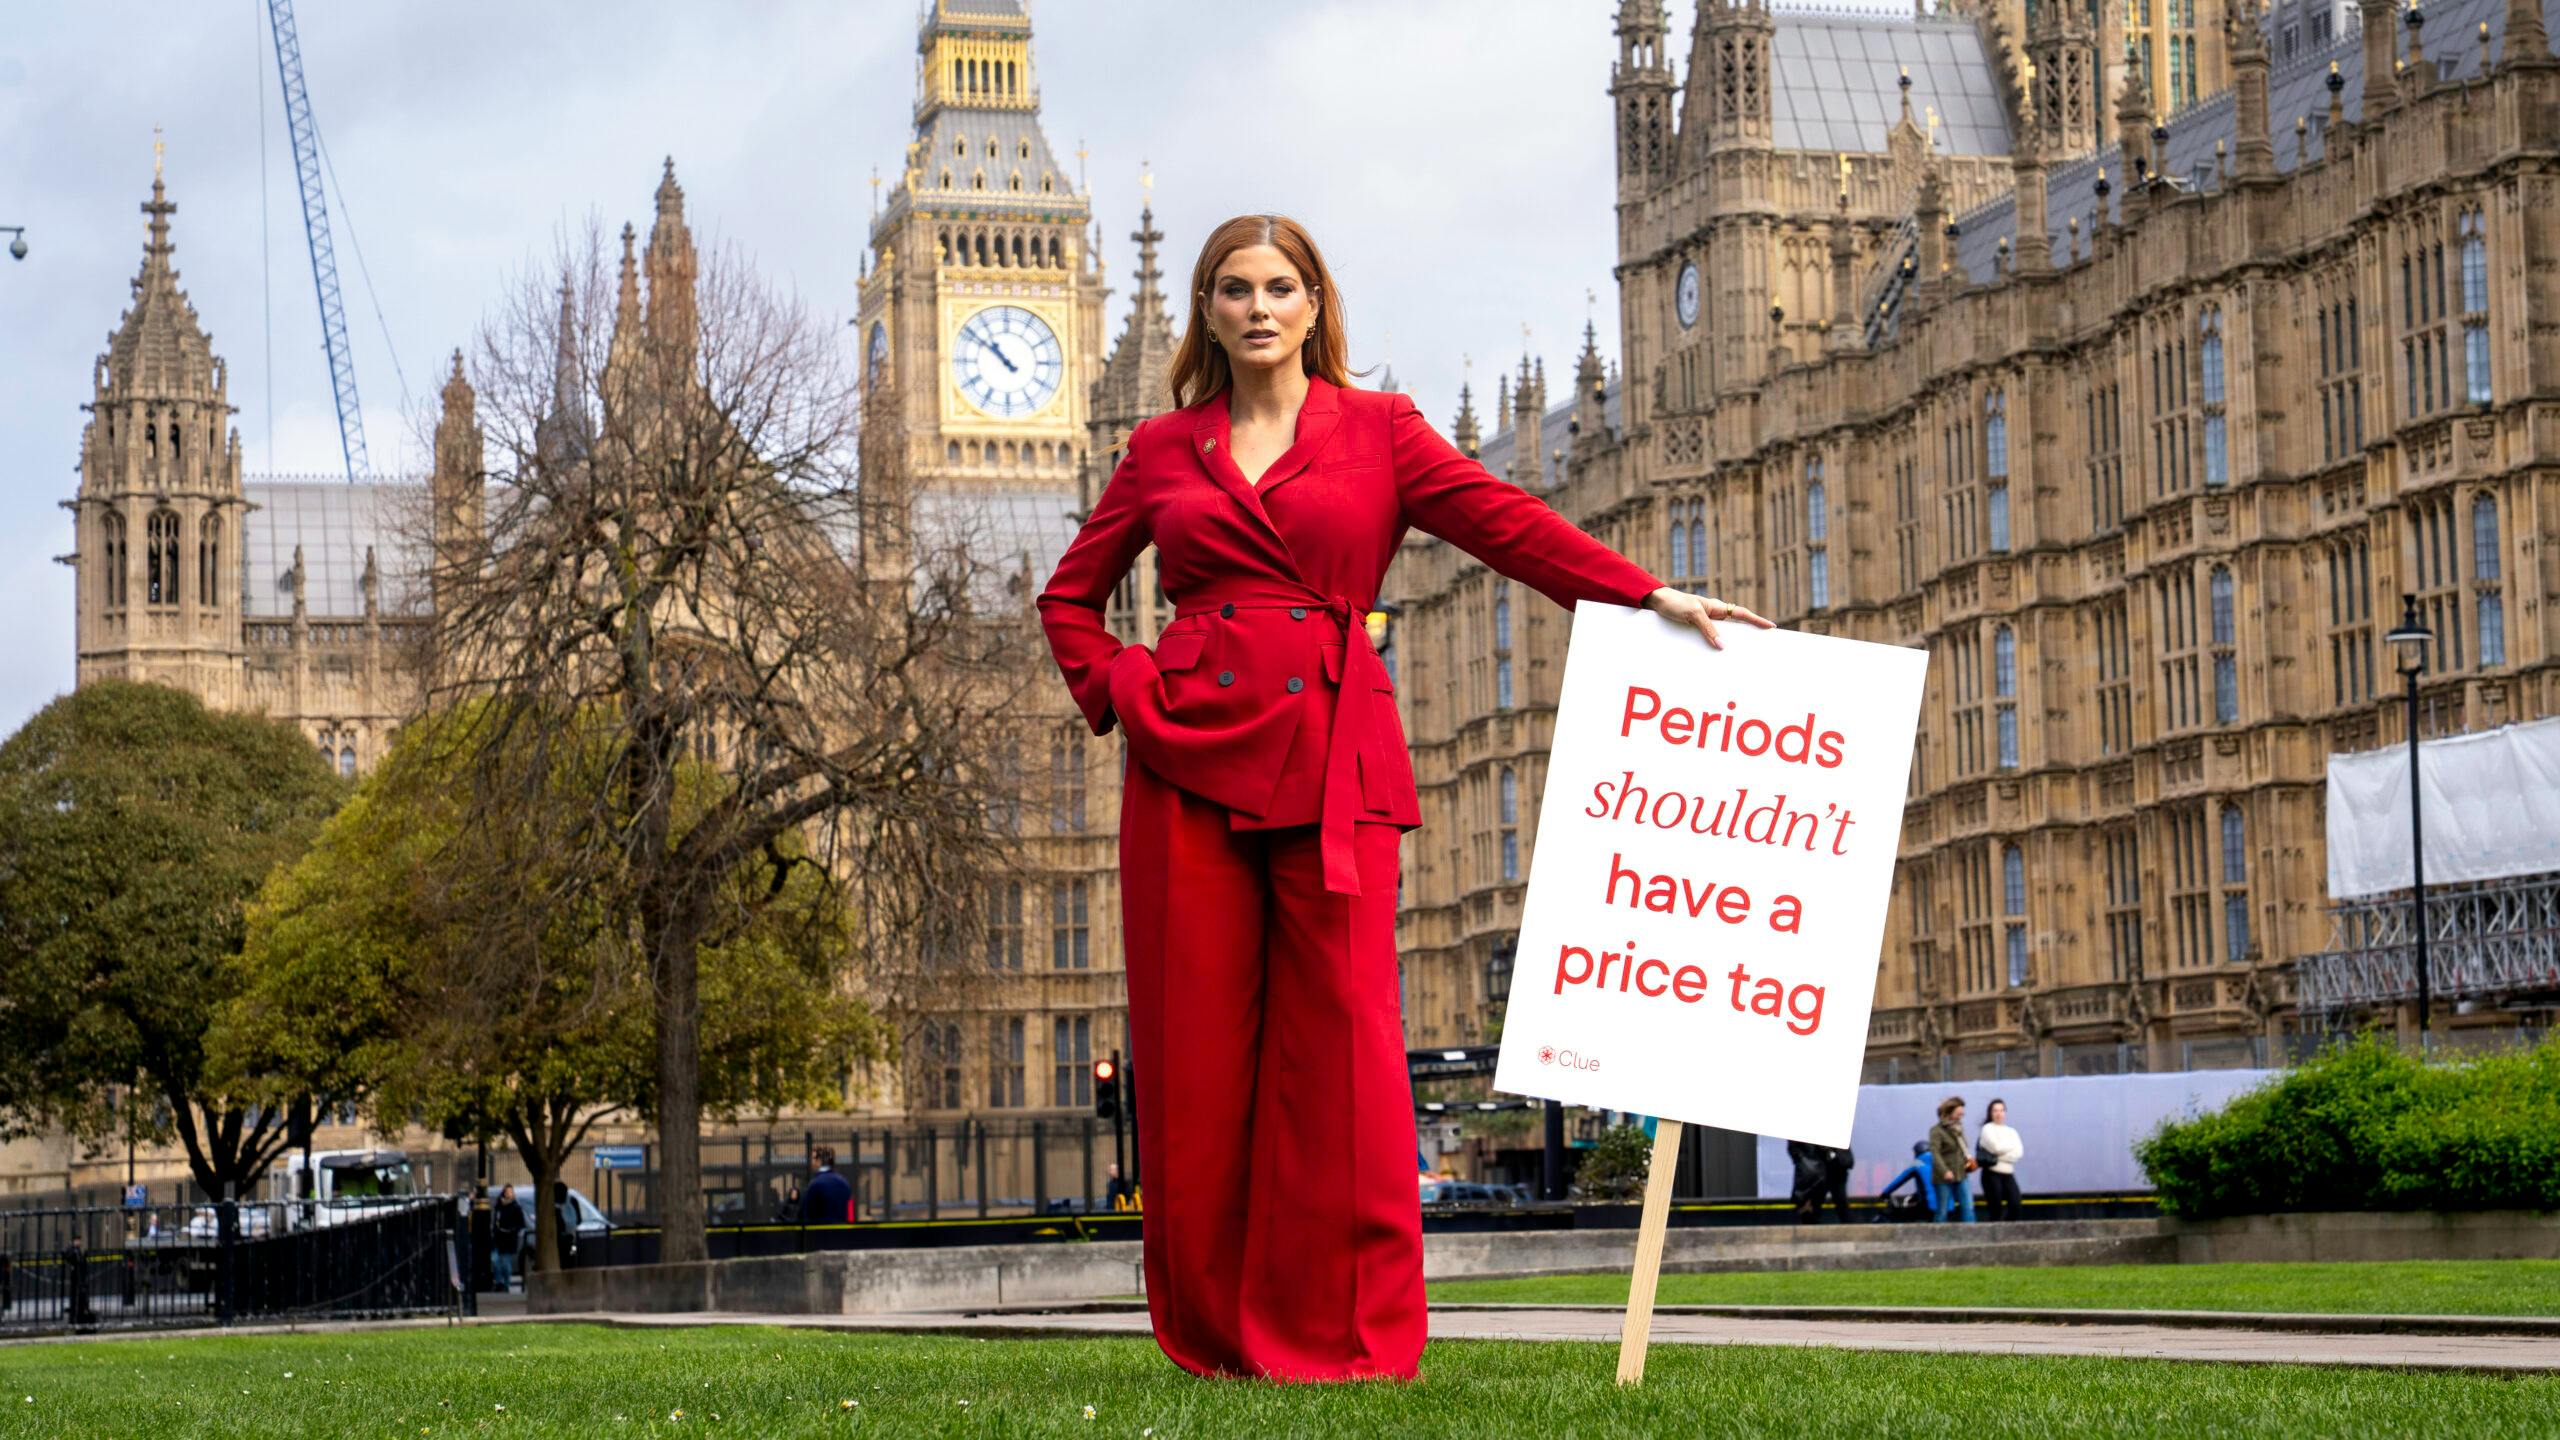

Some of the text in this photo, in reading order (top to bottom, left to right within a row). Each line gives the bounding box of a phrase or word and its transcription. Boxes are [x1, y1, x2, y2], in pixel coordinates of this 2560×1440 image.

[1620, 685, 1845, 769] Periods
[1584, 770, 1856, 856] shouldn’t
[1605, 852, 1803, 935] have a
[1553, 940, 1826, 1037] price tag
[1558, 1049, 1601, 1072] Clue
